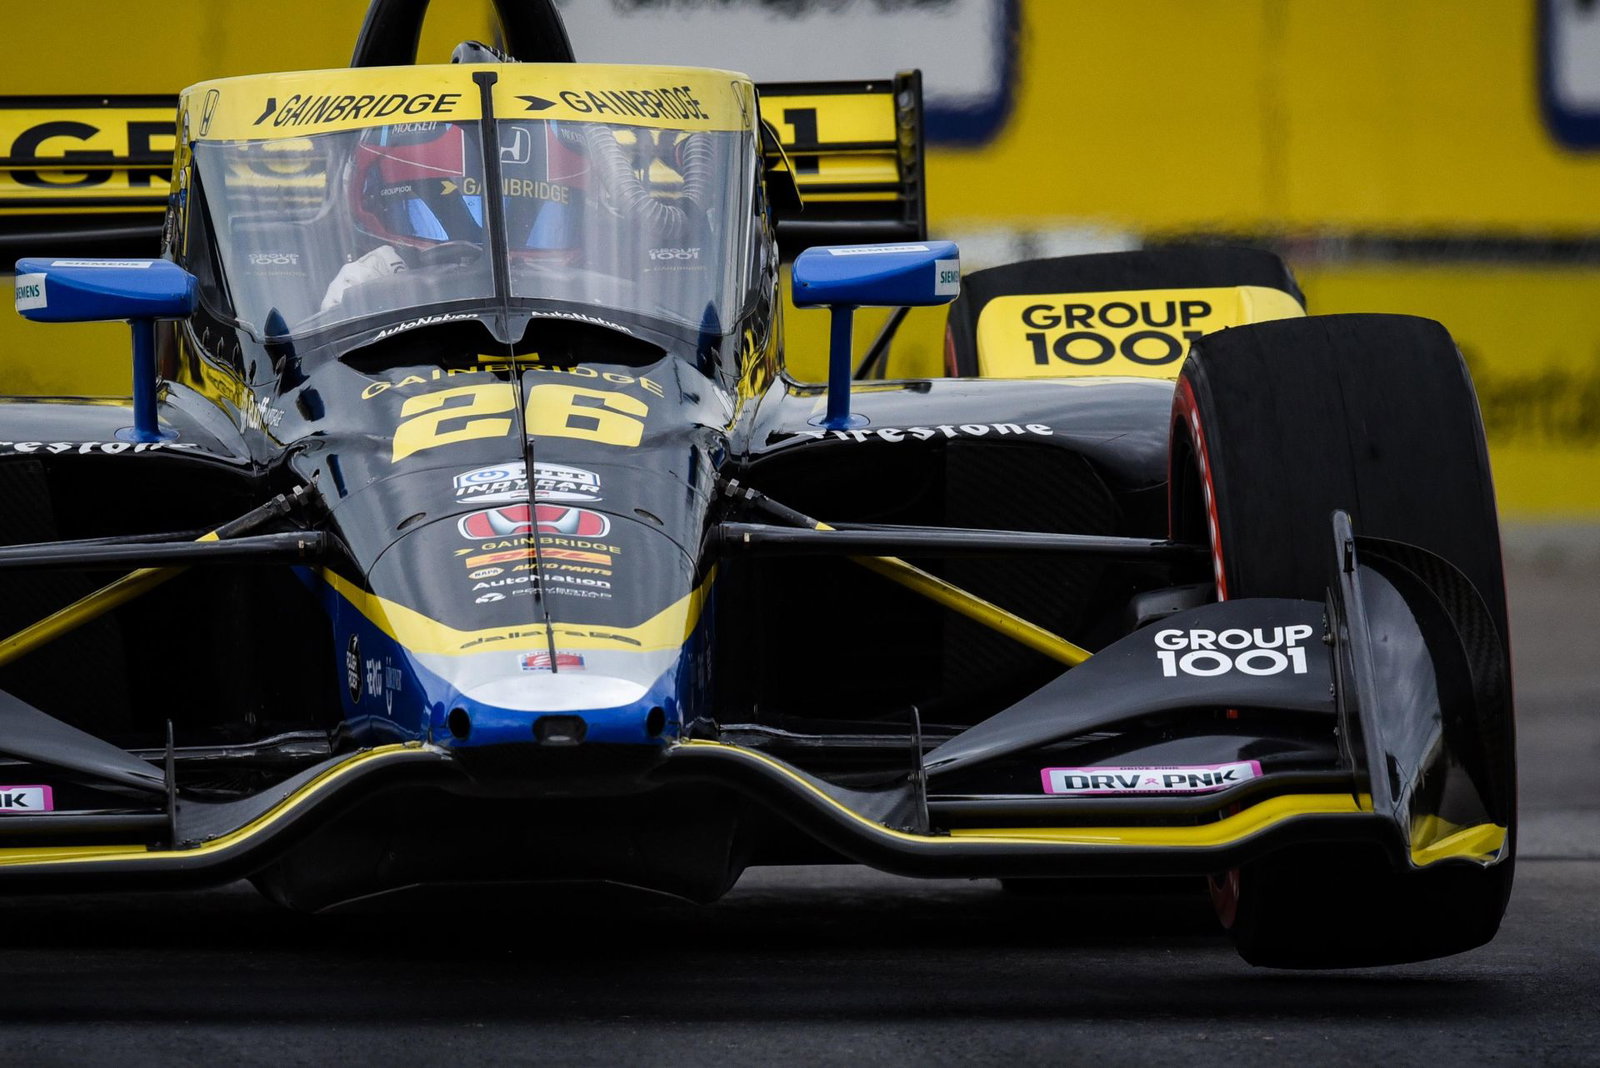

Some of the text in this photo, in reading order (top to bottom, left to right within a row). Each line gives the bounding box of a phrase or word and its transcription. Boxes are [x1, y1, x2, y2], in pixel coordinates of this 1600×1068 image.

[273, 93, 462, 127] GAINBRIDGE
[559, 86, 710, 120] GAINBRIDGE
[373, 313, 480, 342] AutoNation
[531, 311, 634, 335] AutoNation
[1021, 301, 1213, 330] GROUP
[1026, 330, 1203, 366] 100
[361, 363, 666, 400] GAINBRIDGE
[391, 383, 650, 464] 26
[456, 478, 602, 496] INDYCAR
[481, 537, 623, 555] GAINBRIDGE
[472, 573, 612, 592] AutoNation
[560, 563, 614, 576] PARTS
[1154, 624, 1314, 650] GROUP
[1156, 646, 1308, 677] 1001
[1064, 769, 1239, 790] DRV PNK
